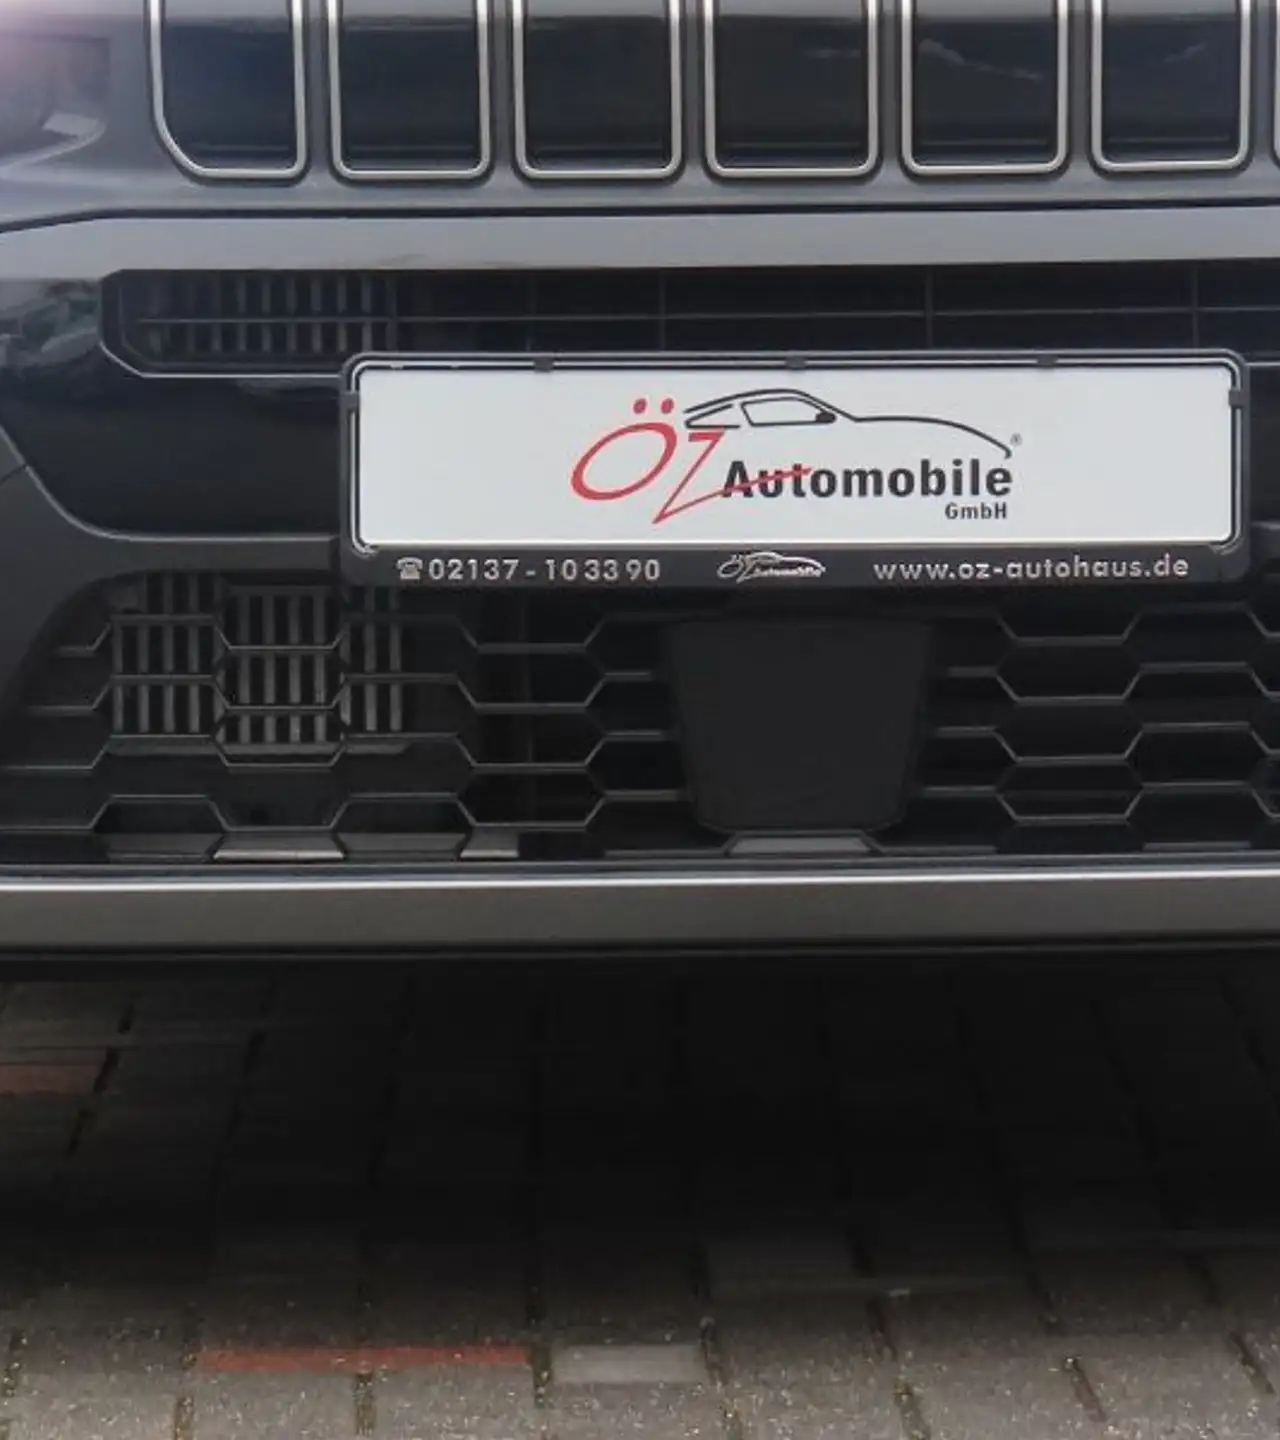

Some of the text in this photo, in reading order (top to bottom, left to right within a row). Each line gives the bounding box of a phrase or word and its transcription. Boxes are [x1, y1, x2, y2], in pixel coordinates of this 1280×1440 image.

[721, 459, 1013, 497] Automobile
[945, 503, 1008, 521] GmbH
[873, 554, 1189, 581] www.oz-autohaus.de
